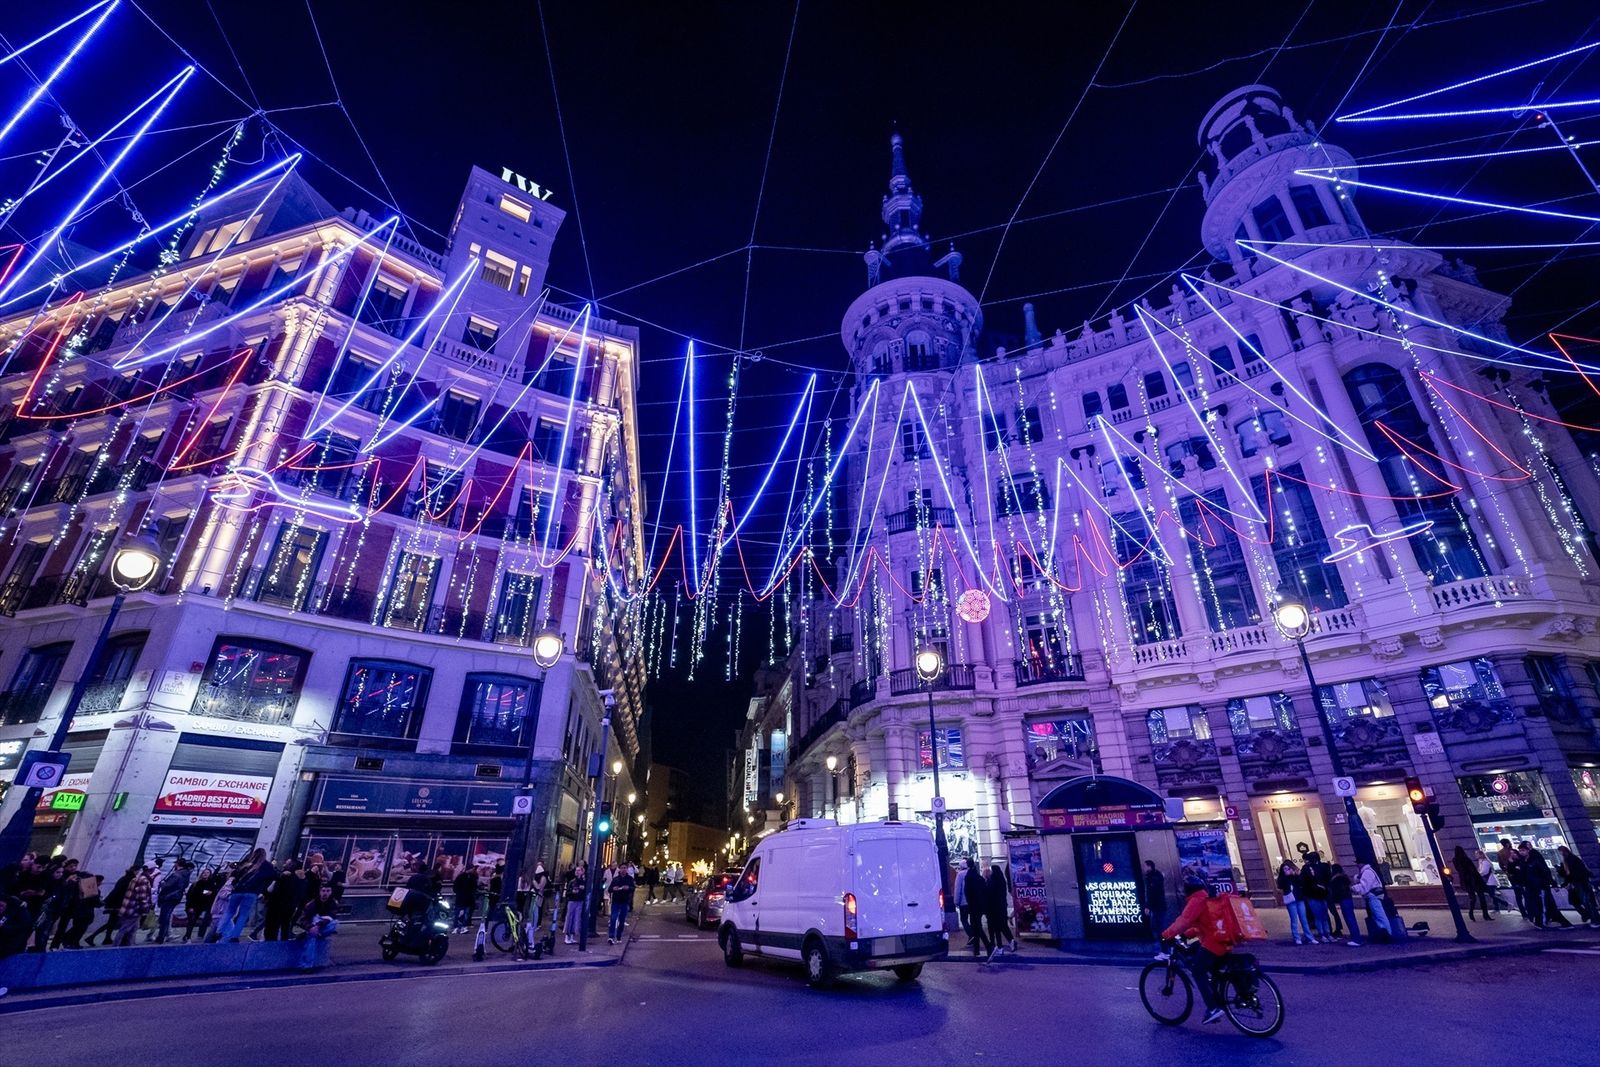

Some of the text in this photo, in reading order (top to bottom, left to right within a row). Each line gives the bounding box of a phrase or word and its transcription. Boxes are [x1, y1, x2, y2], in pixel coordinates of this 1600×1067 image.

[235, 725, 282, 739] EXCHANGE
[68, 778, 90, 787] EXCHAN
[170, 776, 208, 787] CAMBIO
[217, 779, 269, 791] EXCHANGE
[56, 794, 83, 804] ATM
[175, 793, 206, 803] MADRID
[206, 795, 227, 804] BEST
[1476, 794, 1508, 803] Centro
[1098, 812, 1125, 820] MADRID
[1110, 817, 1126, 825] HERE
[1016, 887, 1047, 899] MADRI
[1215, 882, 1233, 895] RID
